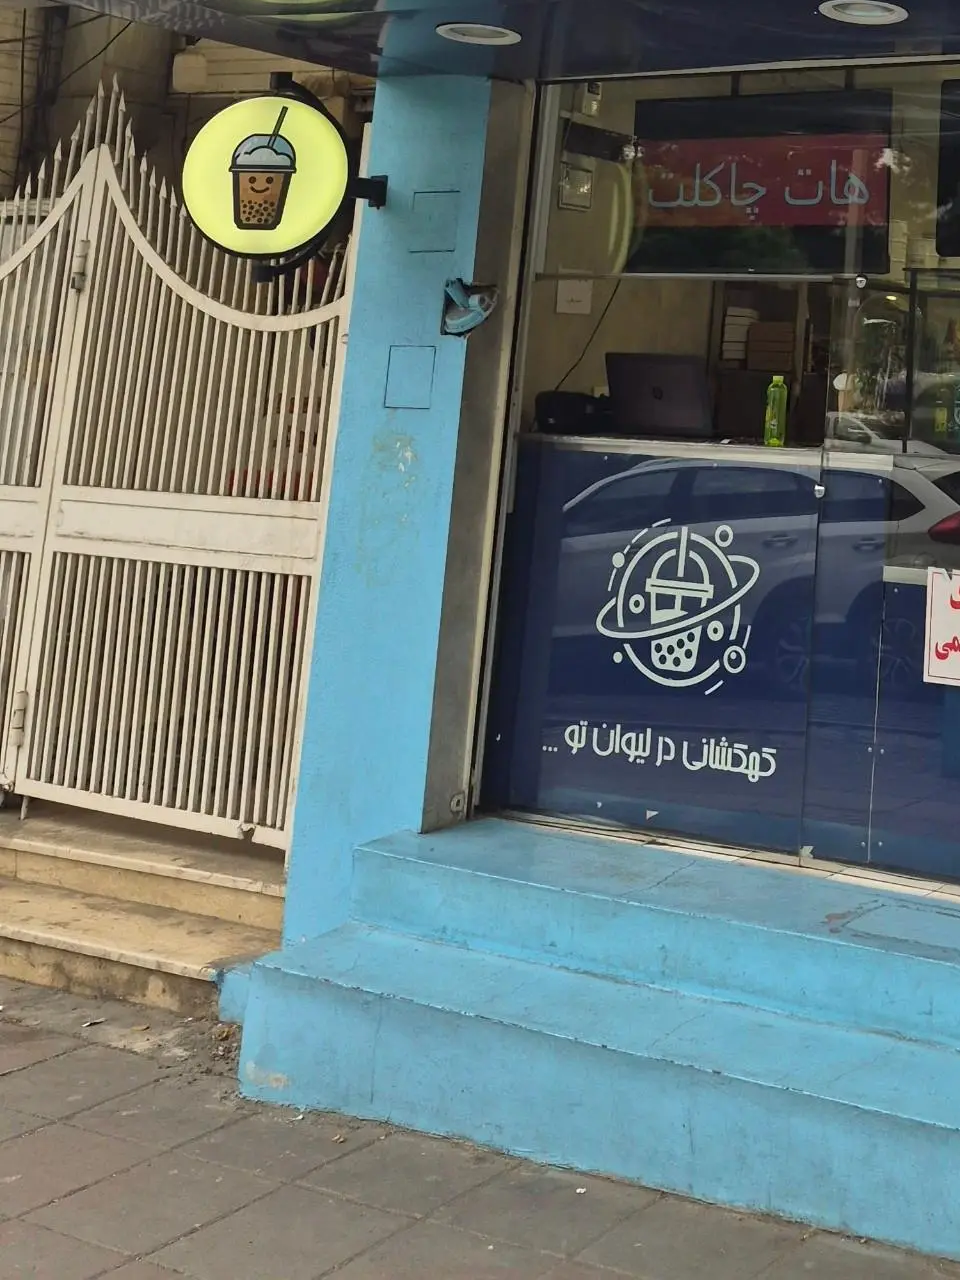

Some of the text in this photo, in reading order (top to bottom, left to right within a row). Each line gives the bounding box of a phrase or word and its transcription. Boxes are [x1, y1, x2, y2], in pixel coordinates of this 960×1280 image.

[648, 159, 870, 220] هات چاکلت
[564, 720, 589, 755] تو
[592, 723, 653, 764] لیوان
[655, 736, 676, 767] در
[682, 736, 777, 783] کهکشانی
